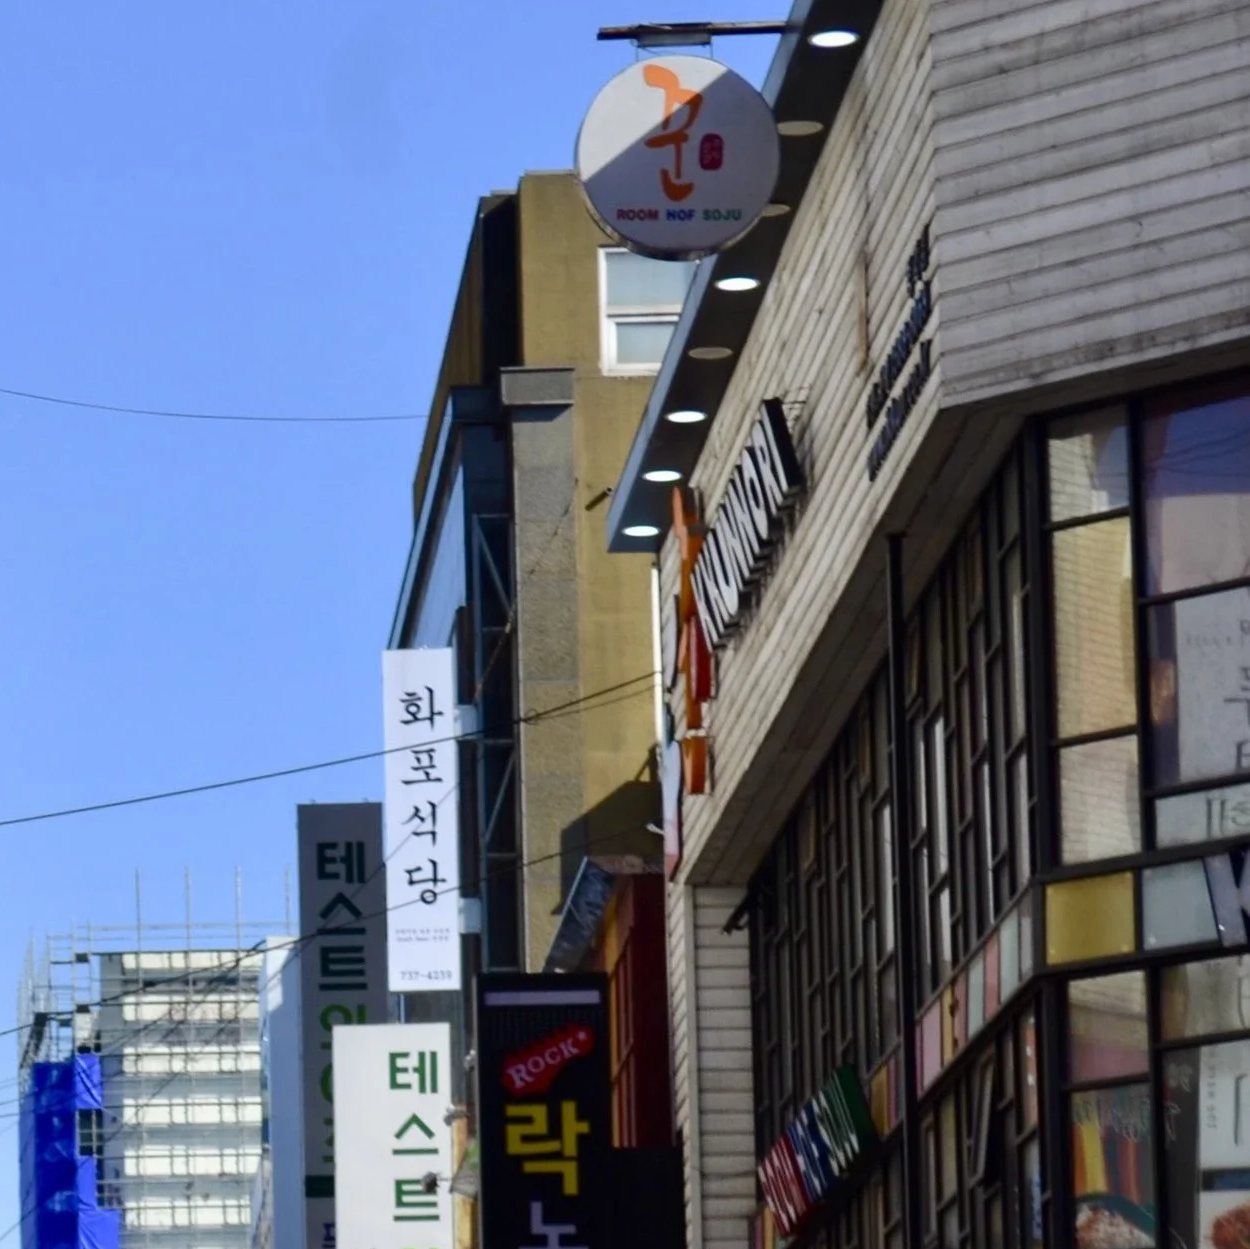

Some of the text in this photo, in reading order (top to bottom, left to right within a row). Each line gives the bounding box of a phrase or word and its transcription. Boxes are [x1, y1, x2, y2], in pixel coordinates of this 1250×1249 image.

[617, 208, 742, 221] ROOM HOF SOJU
[399, 686, 447, 905] 화포식당
[507, 1037, 578, 1089] ROCK
